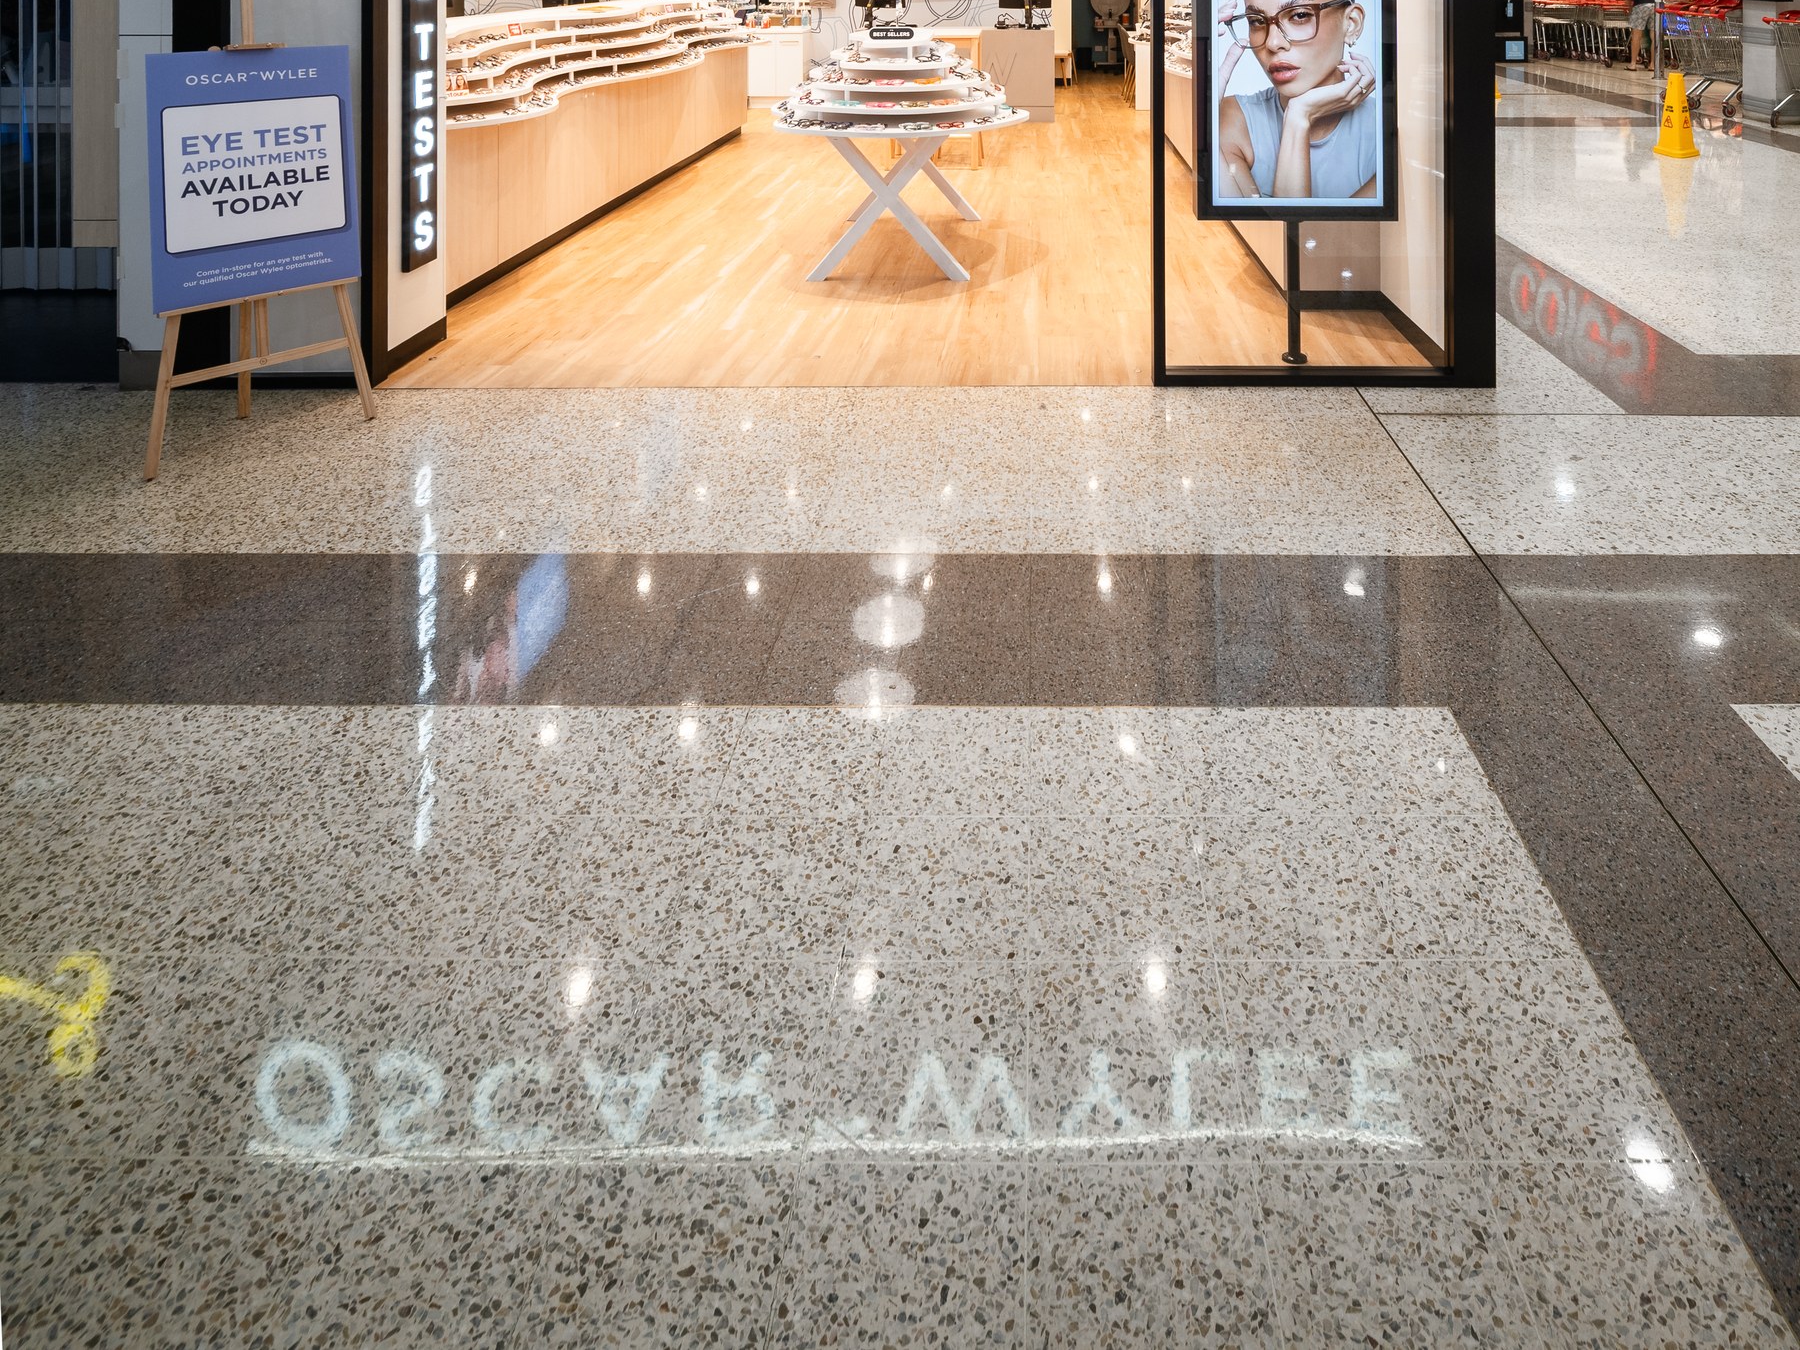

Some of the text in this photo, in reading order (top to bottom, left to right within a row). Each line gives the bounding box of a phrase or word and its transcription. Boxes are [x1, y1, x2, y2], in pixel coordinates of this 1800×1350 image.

[185, 68, 318, 86] OSCAR WYLEE
[181, 124, 327, 156] EYE TEST
[414, 22, 434, 252] TESTS
[182, 148, 328, 175] APPOINTMENTS
[181, 165, 330, 199] AVAILABLE
[213, 190, 304, 217] TODAY
[183, 257, 334, 288] our qualified Oscar Wylee optometrists.
[196, 268, 220, 278] Come
[222, 263, 252, 273] in-store
[253, 260, 265, 269] for
[277, 257, 291, 266] eye
[292, 253, 306, 263] test
[307, 251, 324, 260] with
